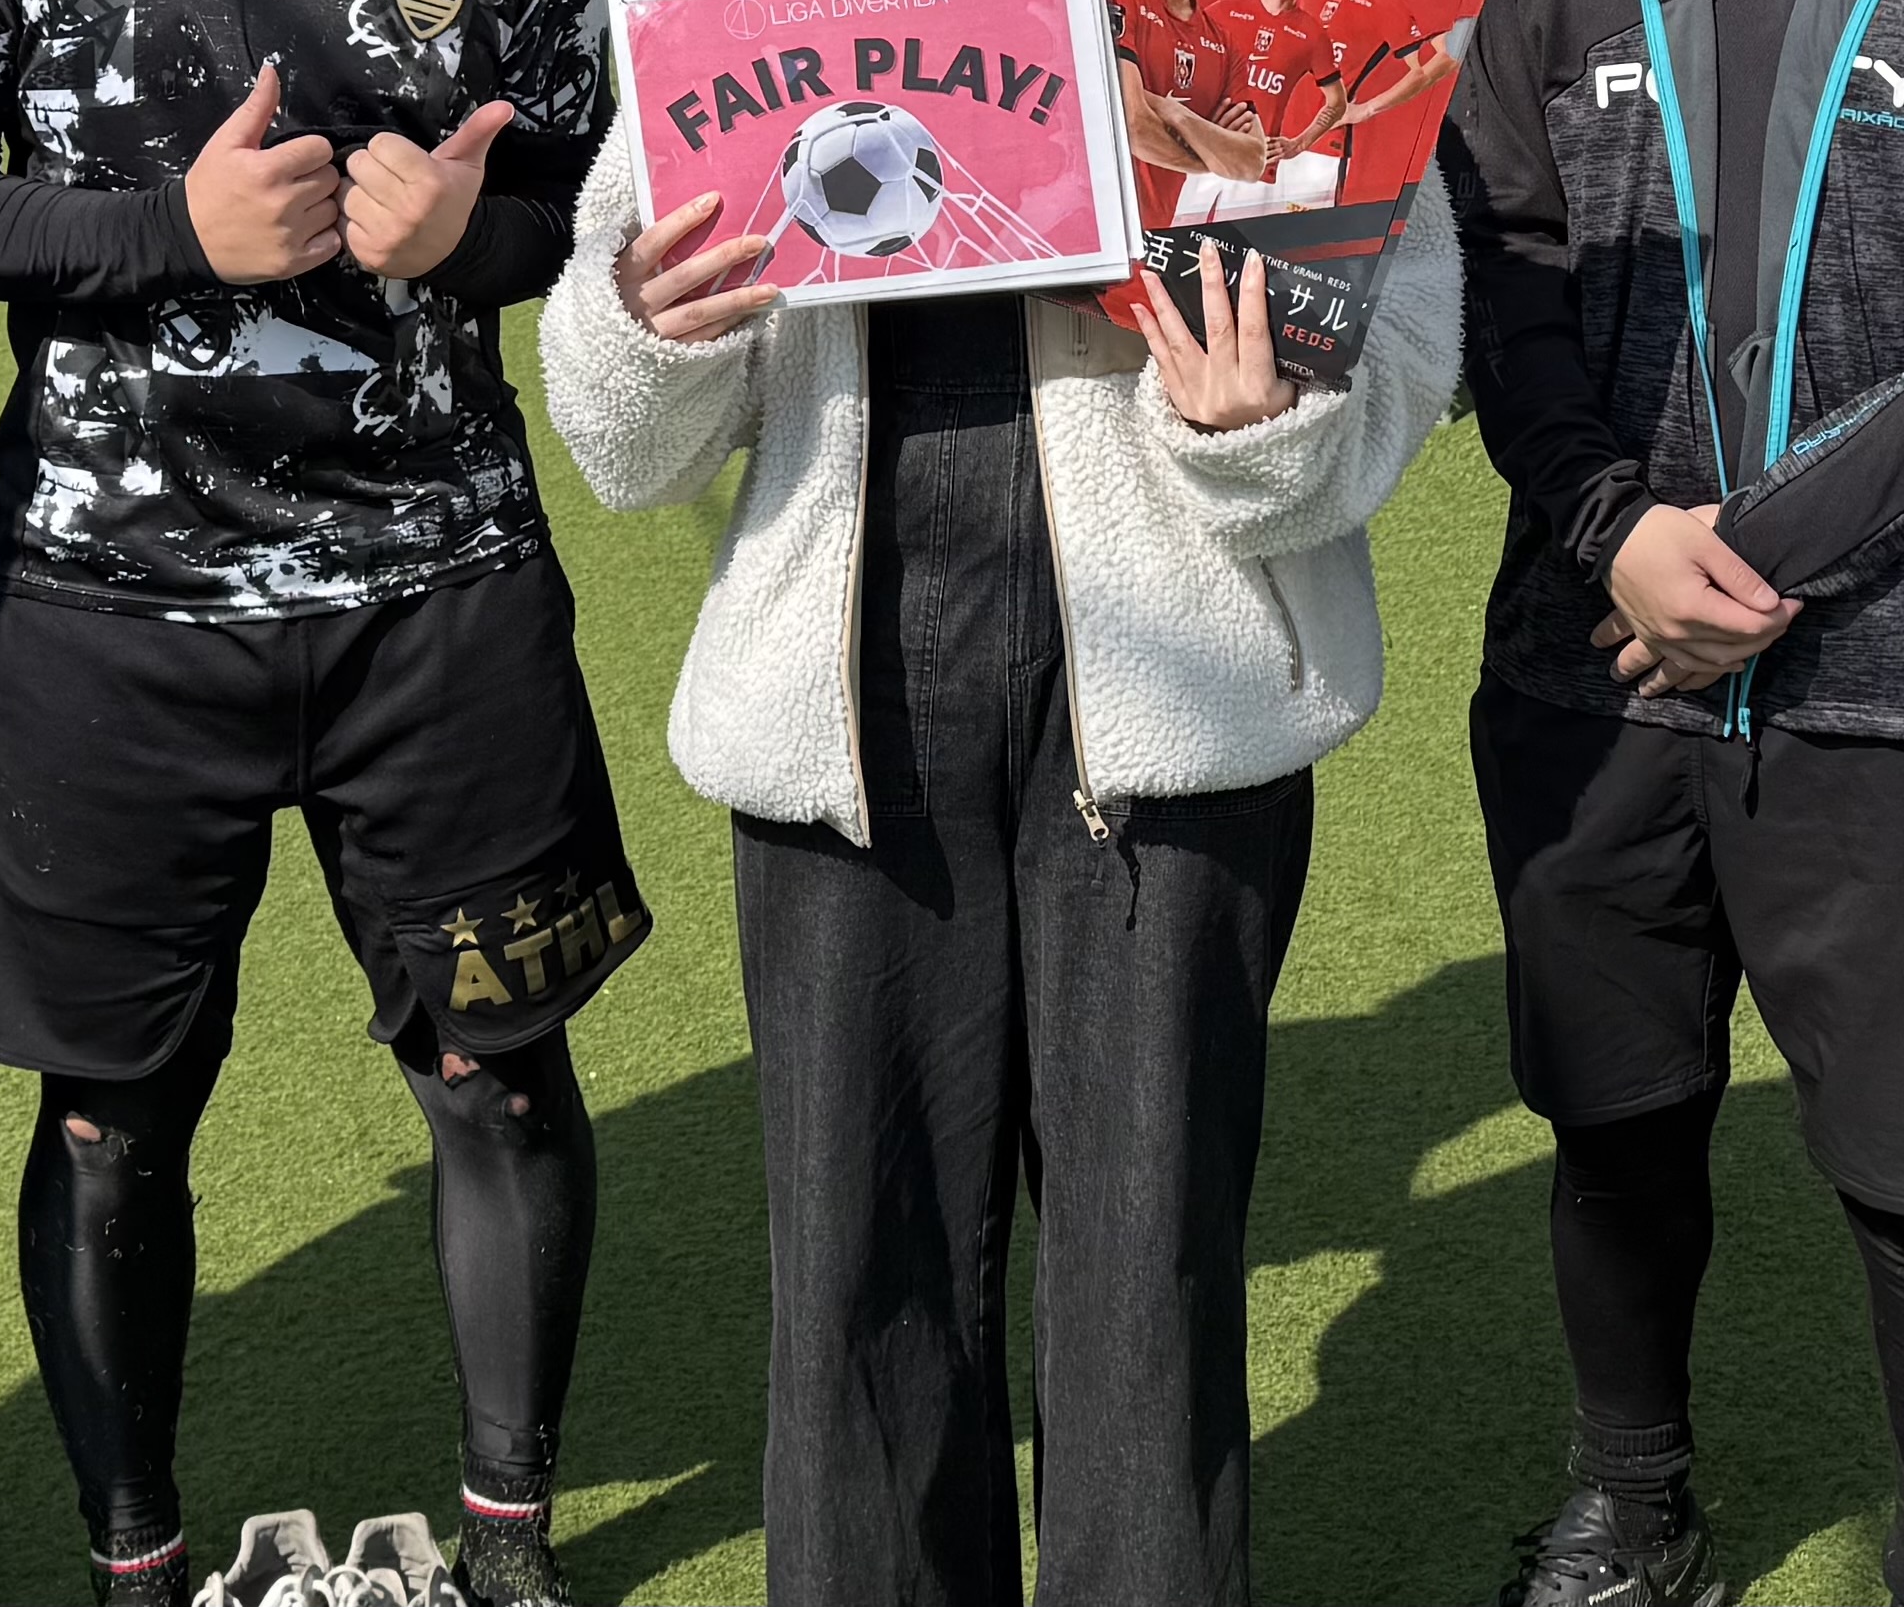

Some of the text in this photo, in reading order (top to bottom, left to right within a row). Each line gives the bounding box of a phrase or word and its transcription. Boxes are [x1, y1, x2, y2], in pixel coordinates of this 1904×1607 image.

[666, 38, 1066, 152] FAIR PLAY!
[1247, 63, 1286, 95] LUS
[1190, 231, 1236, 254] FOBALL
[1327, 276, 1352, 293] REDS
[1283, 323, 1336, 352] REDS
[448, 880, 644, 1012] ATHL
